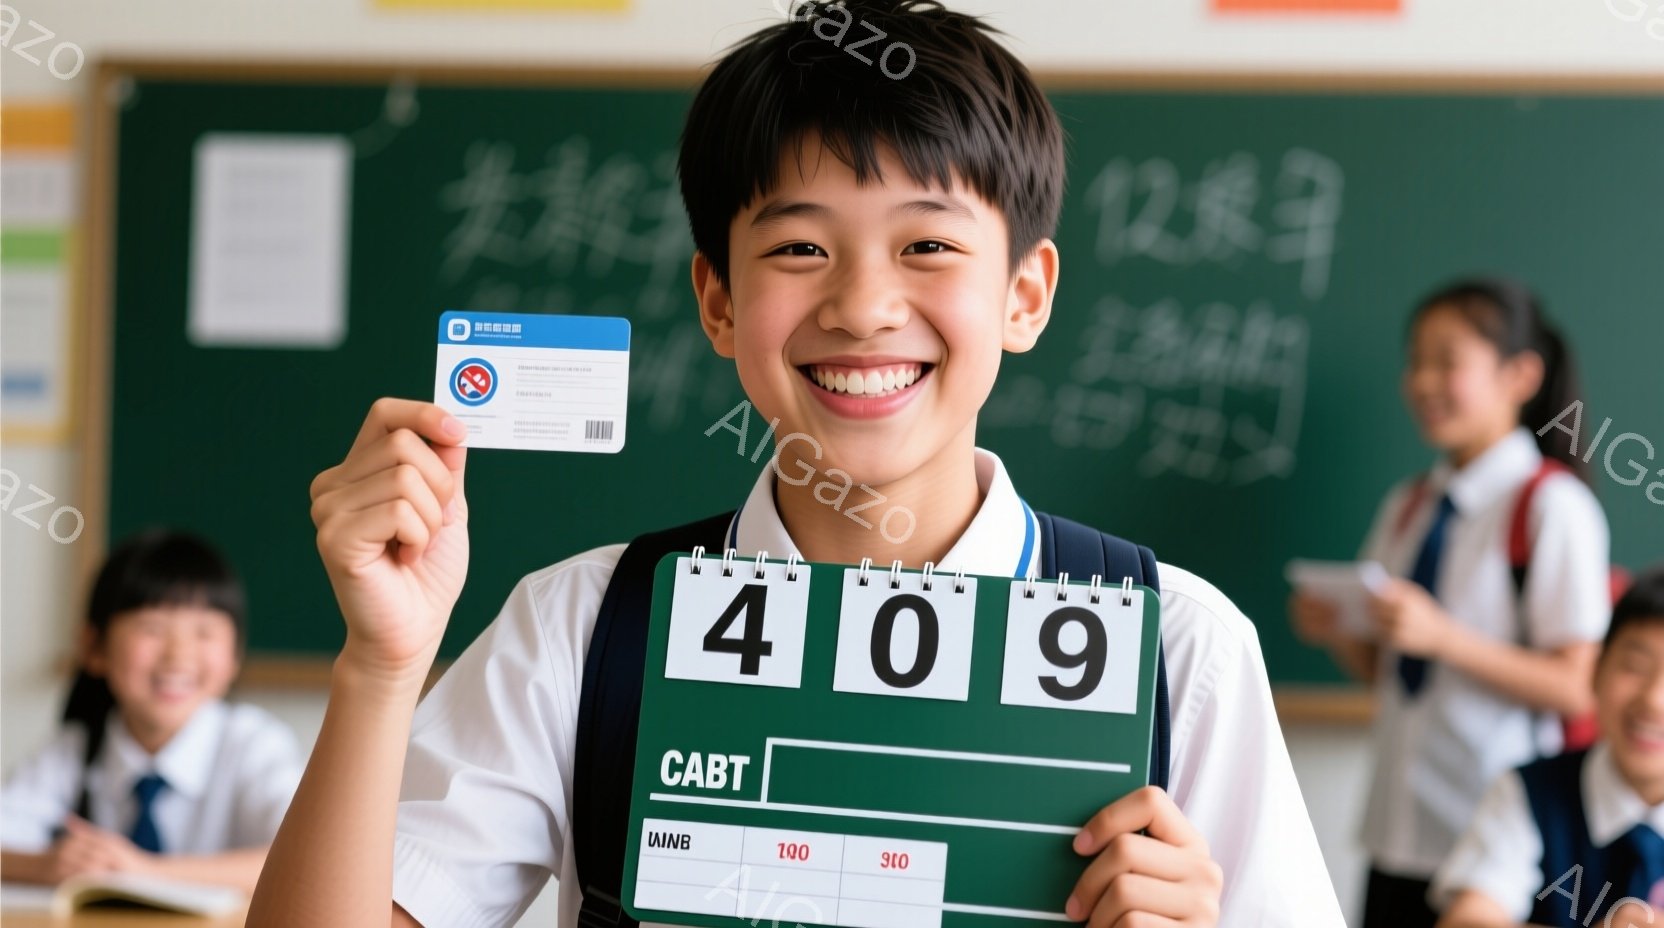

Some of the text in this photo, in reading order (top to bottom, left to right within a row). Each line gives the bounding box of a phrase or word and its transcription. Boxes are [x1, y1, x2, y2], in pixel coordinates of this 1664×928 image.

[702, 584, 1108, 701] 4 0 9
[660, 749, 750, 791] CABT
